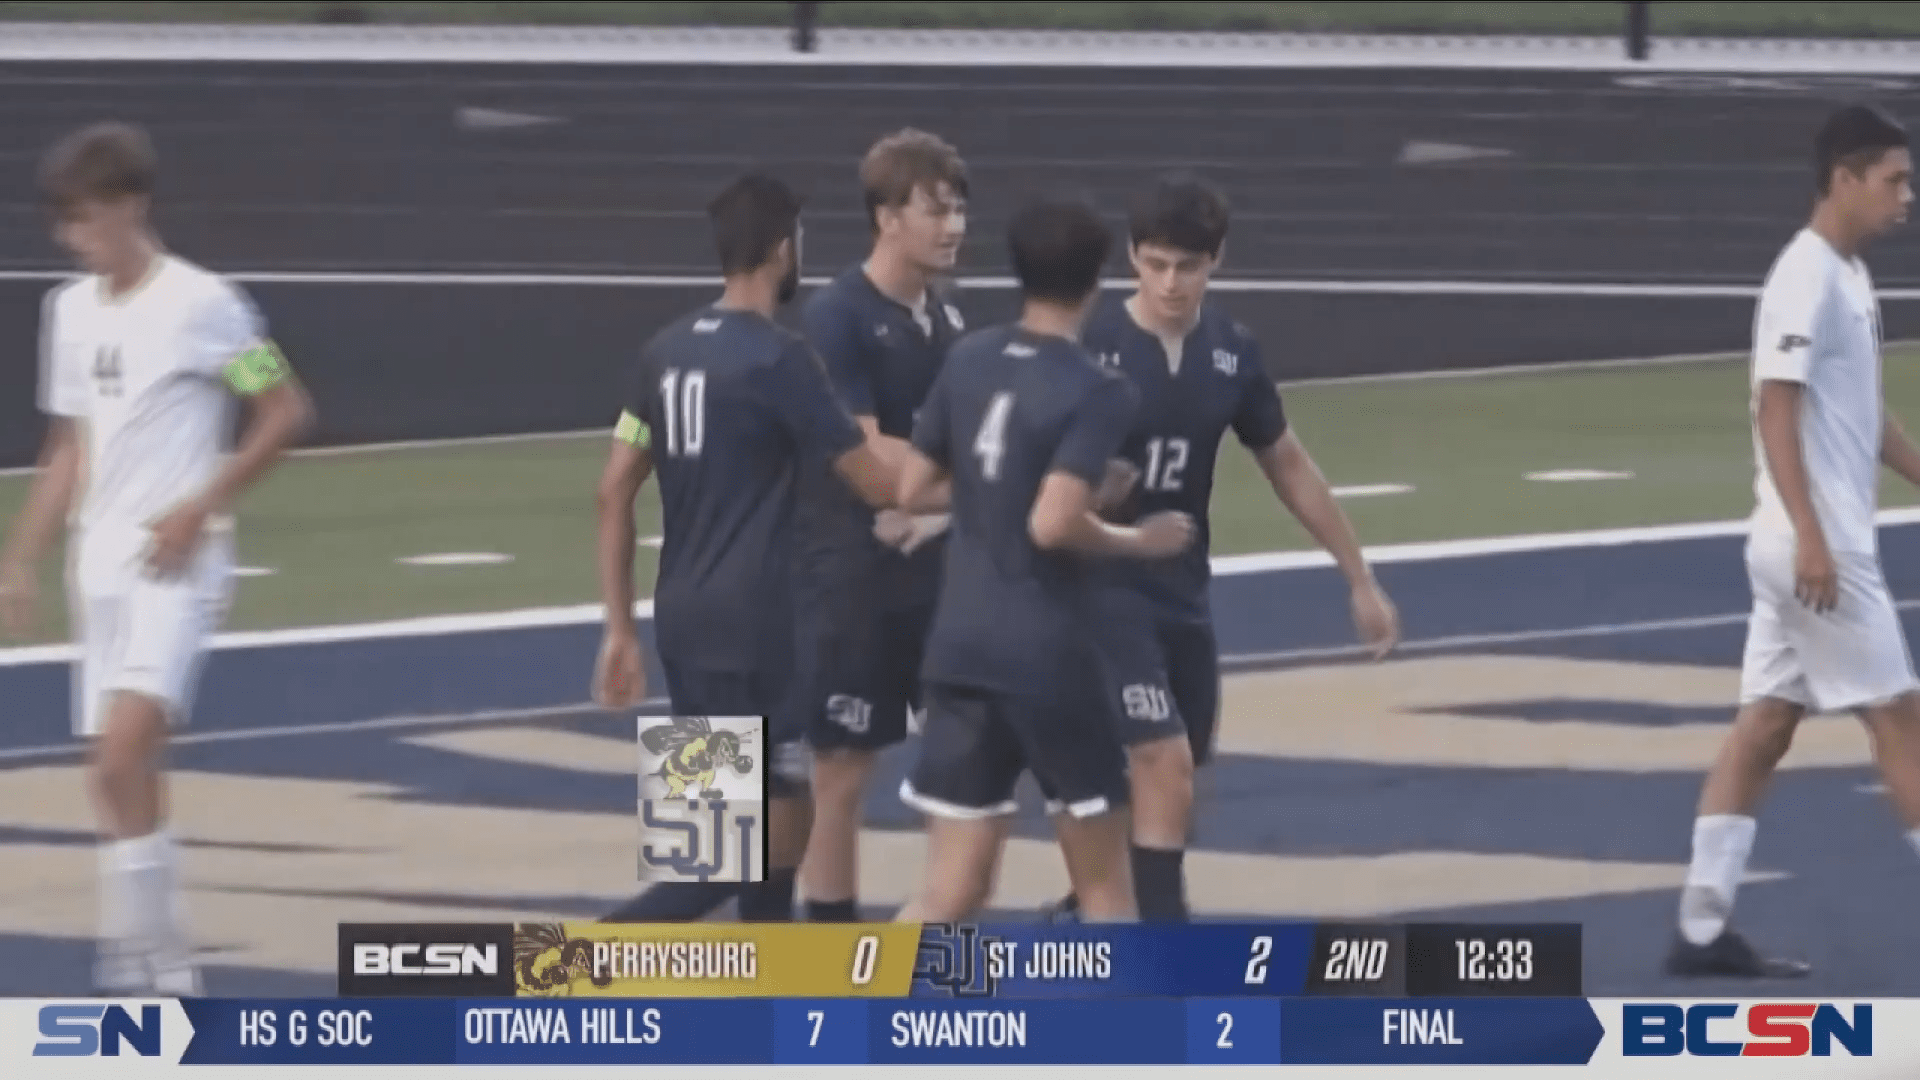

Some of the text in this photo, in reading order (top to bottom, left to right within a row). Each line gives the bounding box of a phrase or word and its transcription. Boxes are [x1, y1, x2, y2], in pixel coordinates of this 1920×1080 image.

[660, 367, 706, 457] 10
[973, 393, 1014, 480] 4
[1144, 438, 1190, 490] 12
